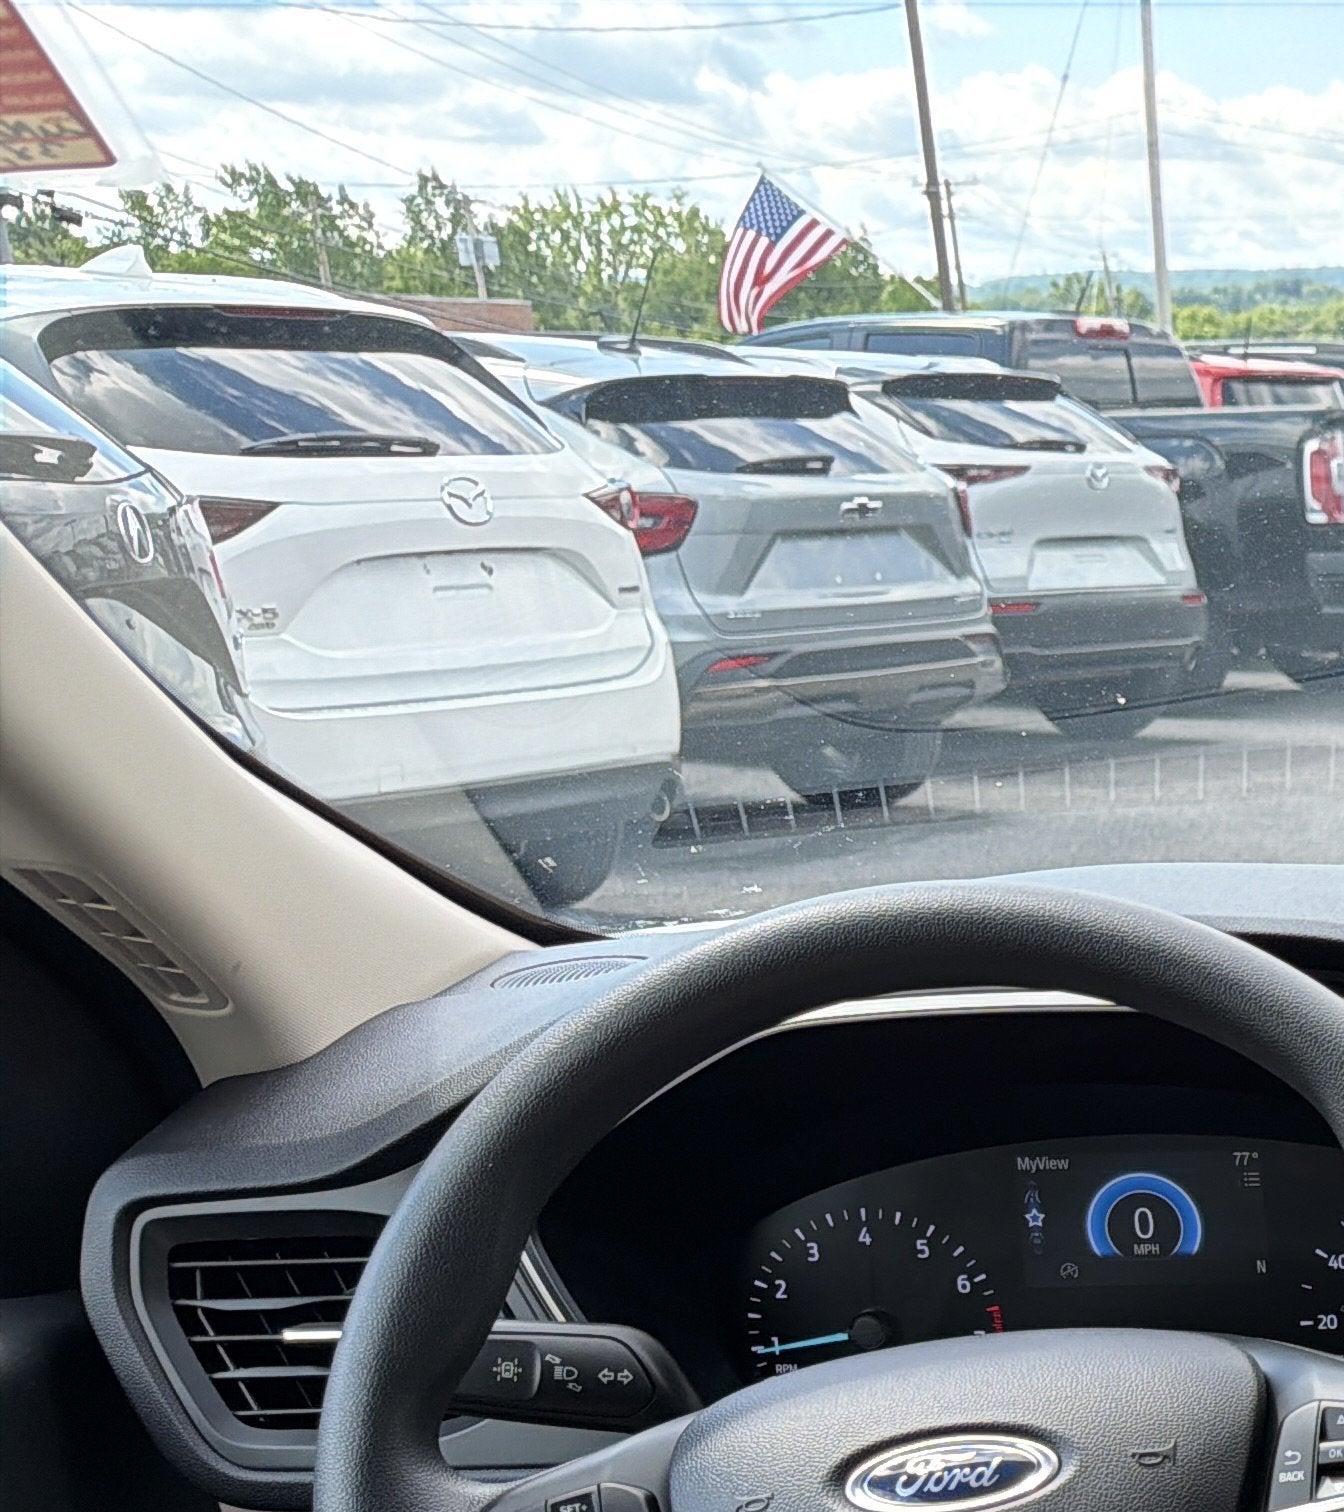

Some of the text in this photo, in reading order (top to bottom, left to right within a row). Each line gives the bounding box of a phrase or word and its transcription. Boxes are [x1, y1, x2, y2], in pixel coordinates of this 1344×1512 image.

[234, 606, 279, 623] X-5
[1016, 1156, 1070, 1174] MyView
[1232, 1151, 1260, 1167] 77°
[1133, 1206, 1155, 1240] 0
[858, 1226, 873, 1246] 4
[805, 1242, 820, 1262] 3
[915, 1239, 930, 1259] 5
[1133, 1243, 1161, 1256] MPH
[1256, 1259, 1268, 1275] N
[773, 1279, 788, 1299] 2
[956, 1274, 971, 1294] 6
[1316, 1314, 1339, 1330] 20
[1328, 1448, 1344, 1459] OK
[894, 1450, 1004, 1498] Ford
[1278, 1470, 1306, 1483] BACK
